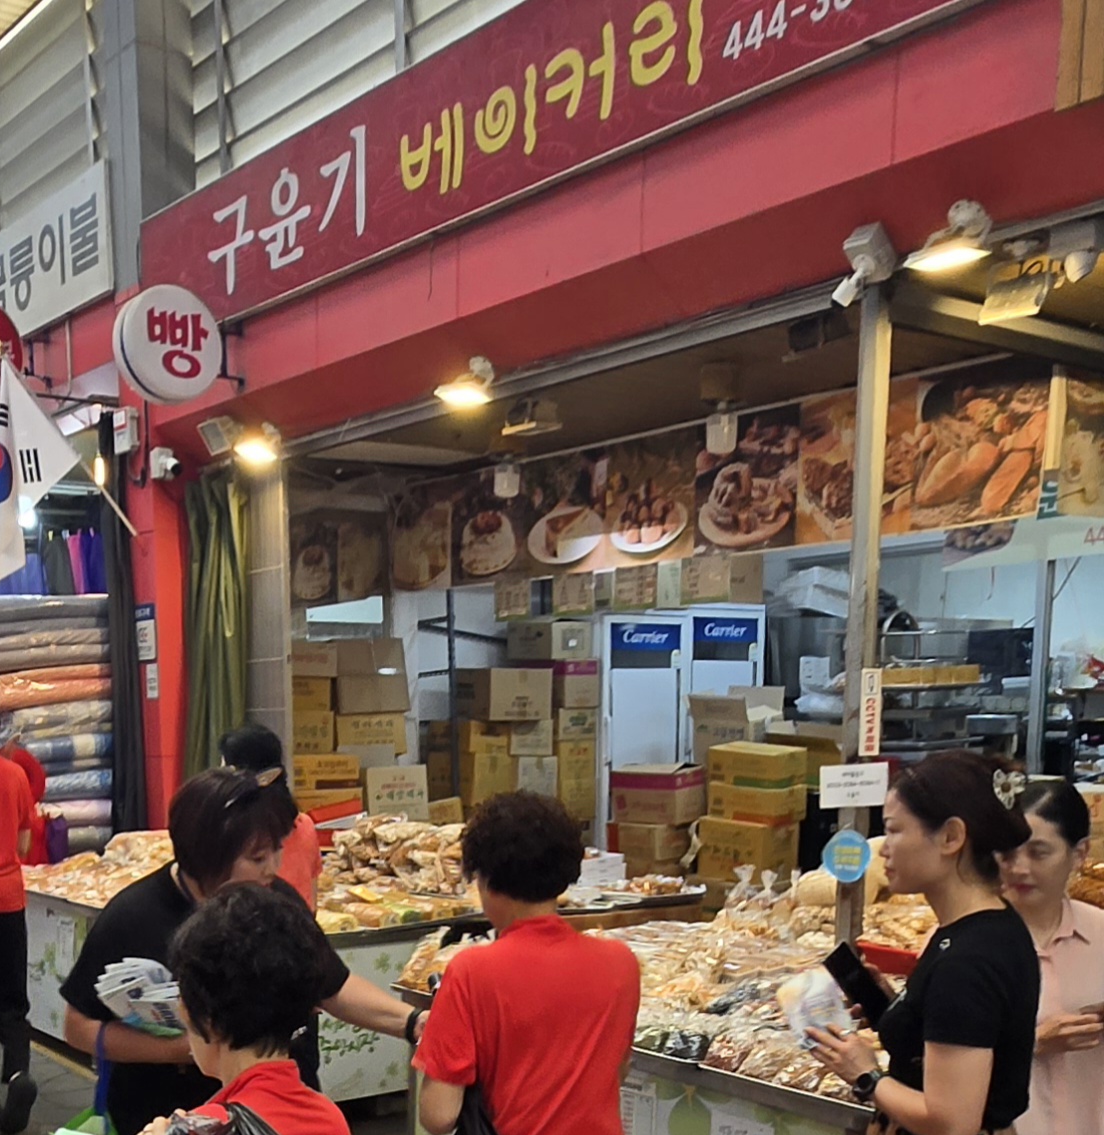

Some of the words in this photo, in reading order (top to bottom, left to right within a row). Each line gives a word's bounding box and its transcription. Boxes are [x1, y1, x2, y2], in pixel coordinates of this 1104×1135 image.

[207, 125, 366, 295] 구윤기
[400, 0, 703, 195] 베이커리
[147, 306, 209, 379] 빵
[622, 629, 670, 645] Carrier
[704, 622, 748, 639] Carrier
